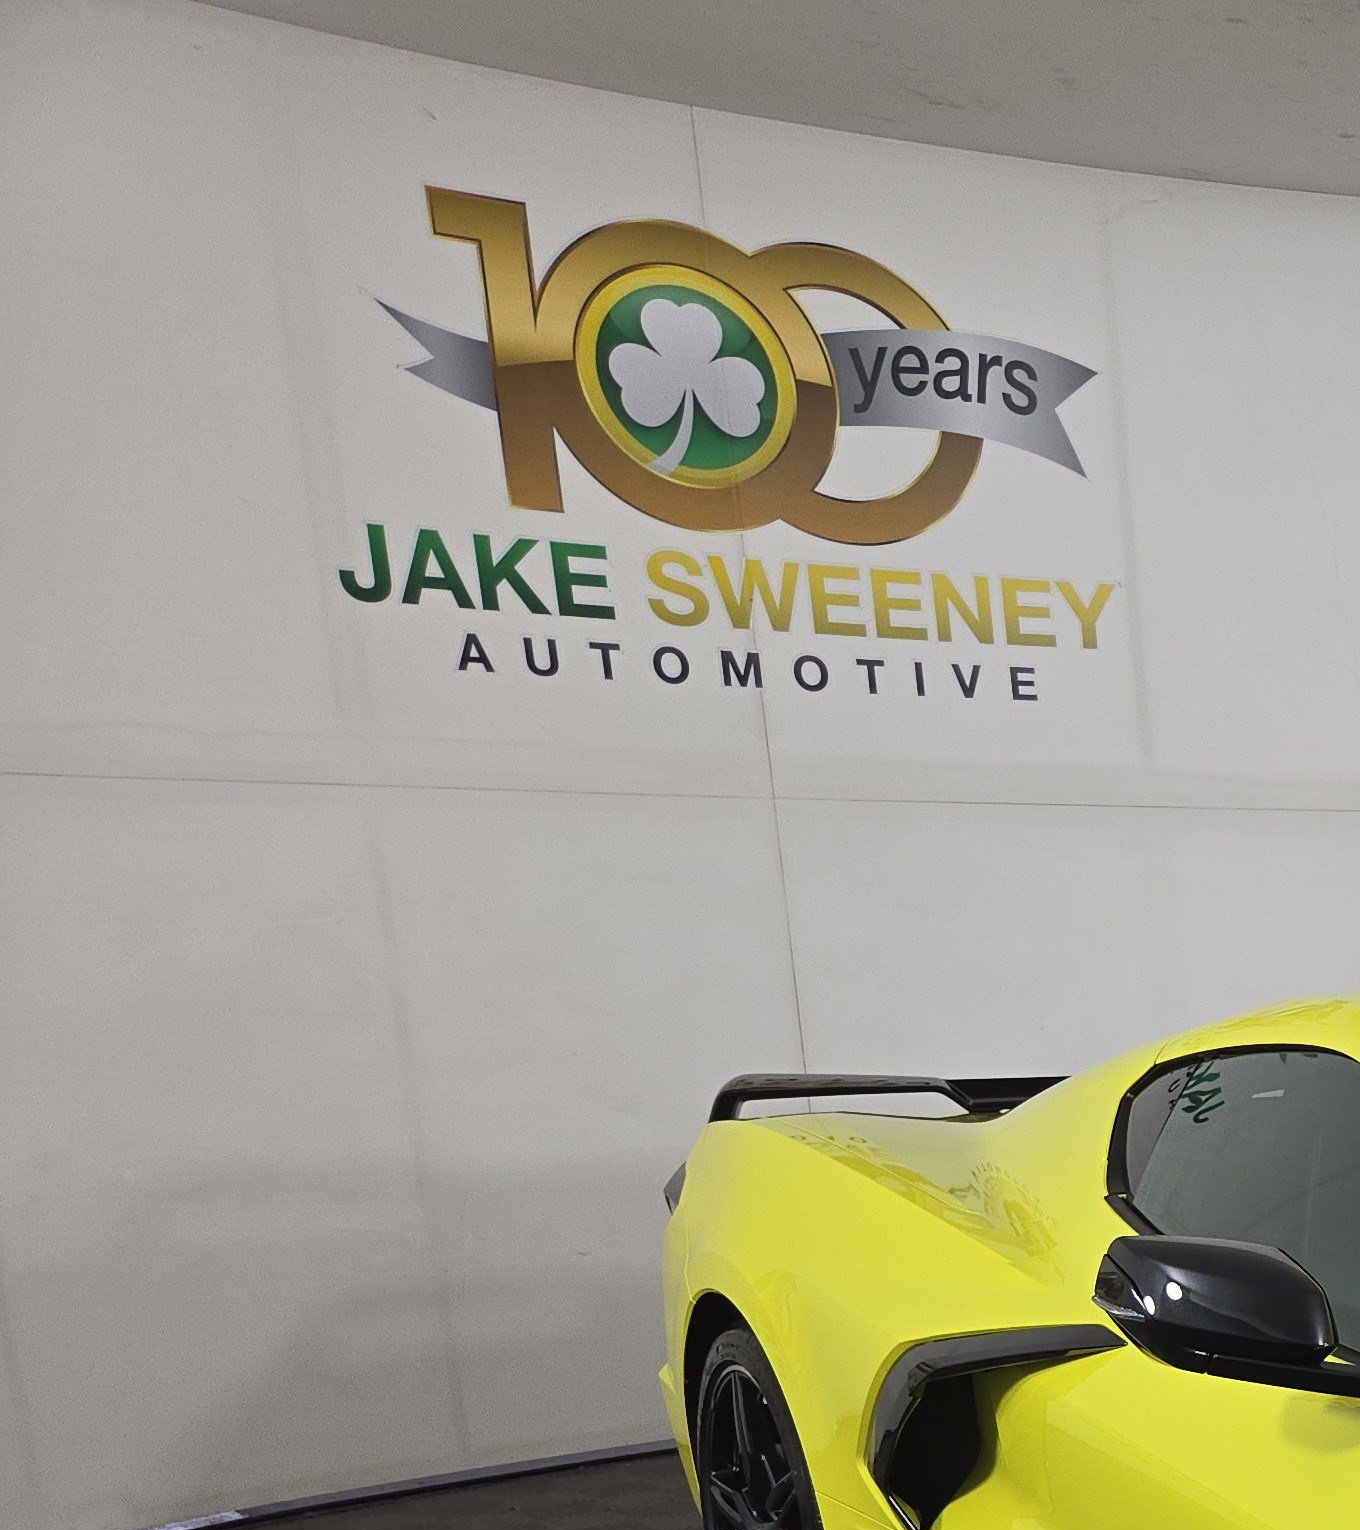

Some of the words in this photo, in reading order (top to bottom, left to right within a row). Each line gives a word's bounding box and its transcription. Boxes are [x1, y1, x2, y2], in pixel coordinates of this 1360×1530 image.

[424, 185, 983, 546] 100
[848, 343, 1039, 416] years
[338, 523, 617, 620] JAKE
[646, 549, 1117, 650] SWEENEY
[457, 632, 1039, 702] AUTOMOTIVE
